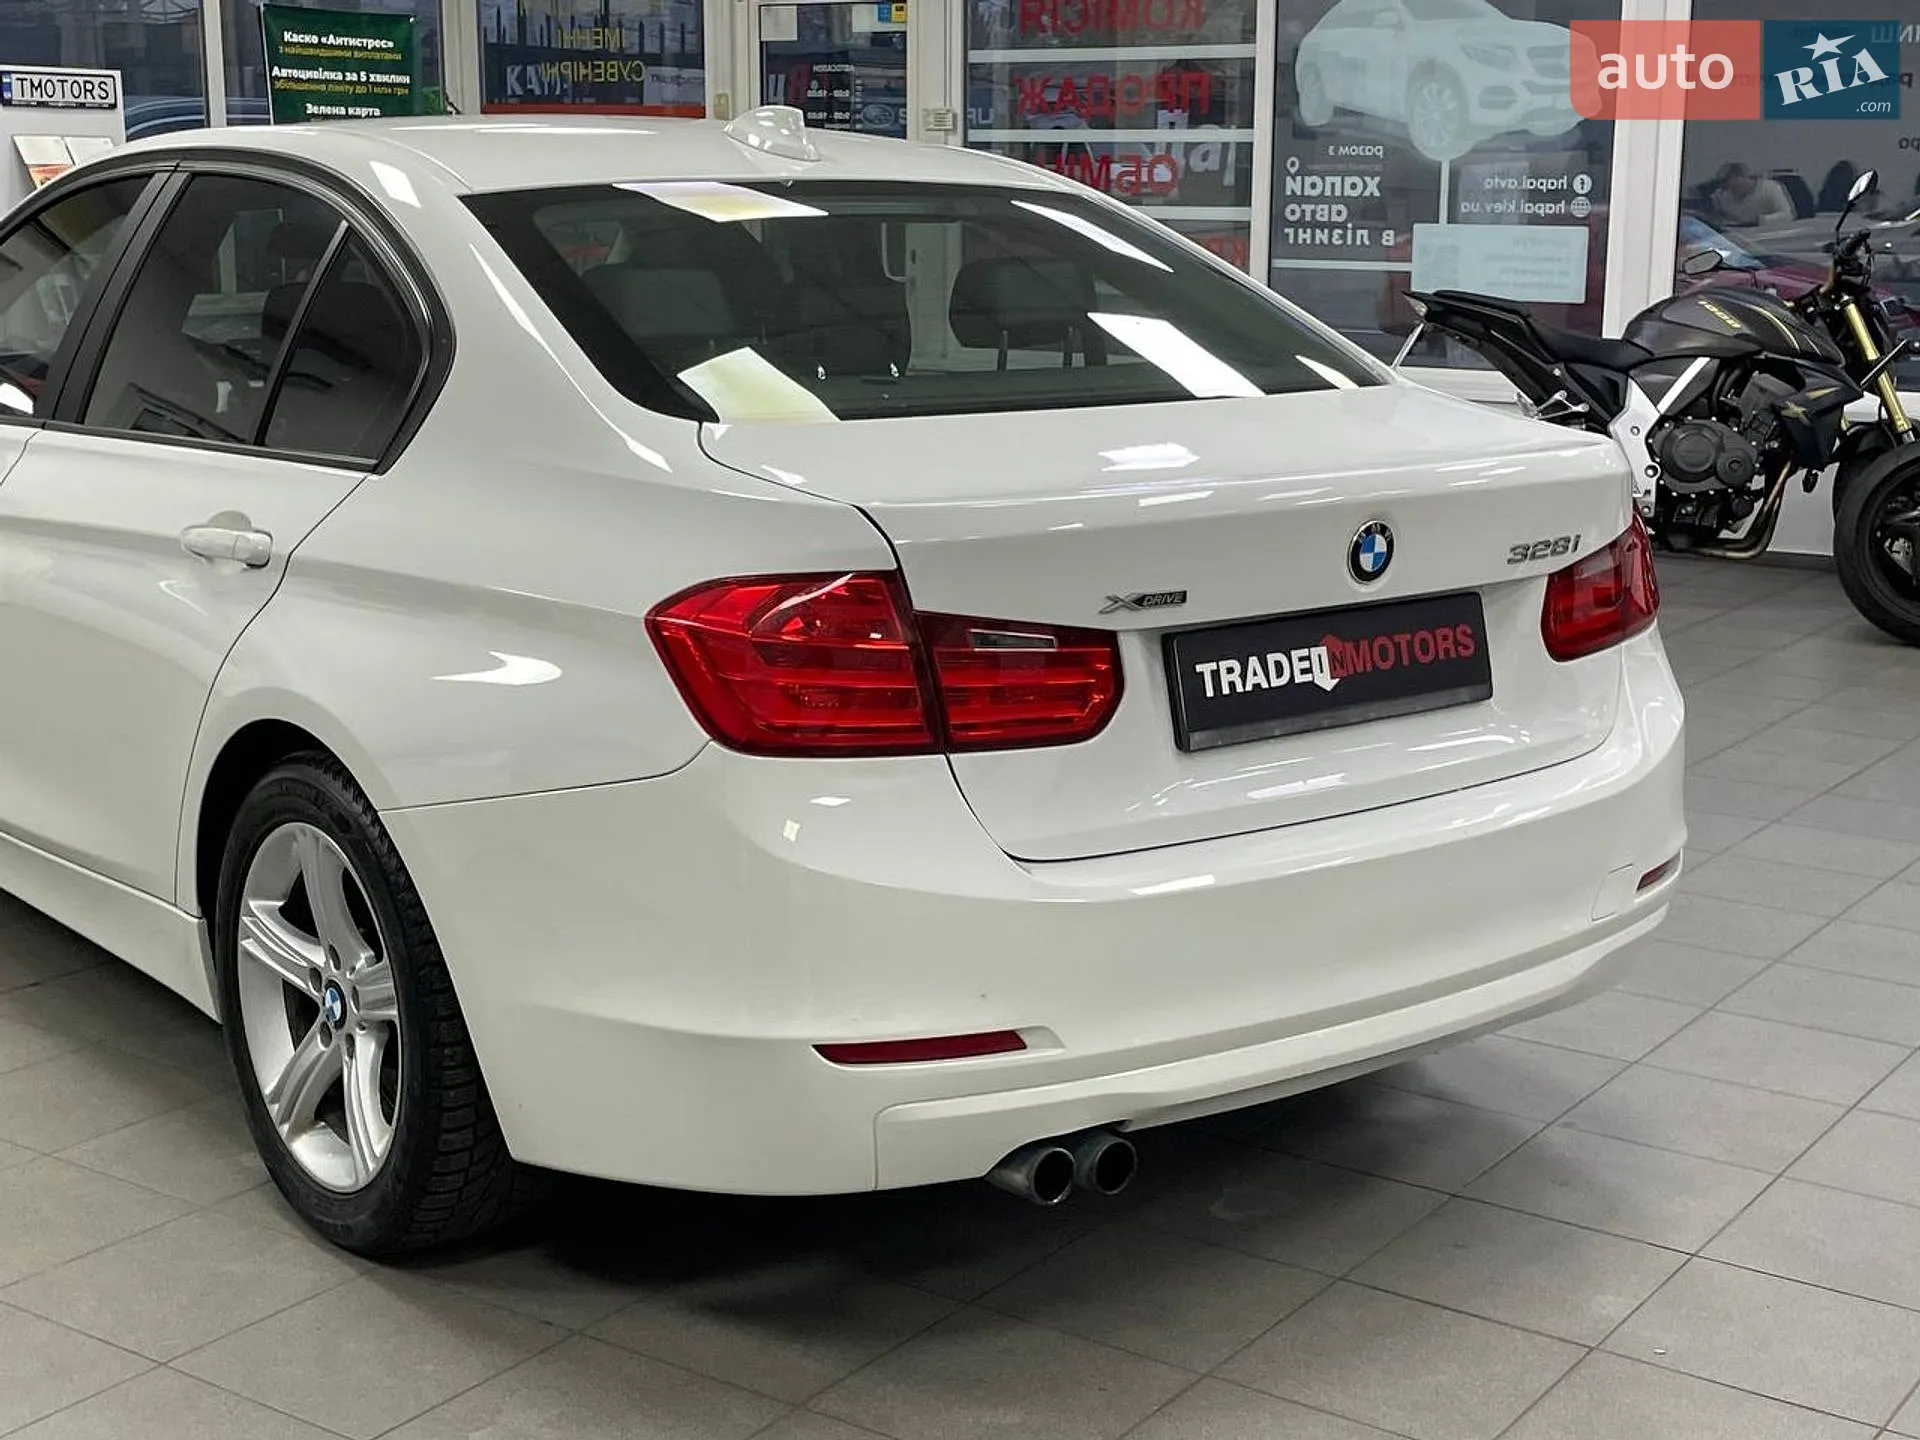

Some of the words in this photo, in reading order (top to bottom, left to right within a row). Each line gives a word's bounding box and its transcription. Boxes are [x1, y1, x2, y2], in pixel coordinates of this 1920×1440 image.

[283, 31, 319, 44] Каско
[272, 66, 343, 81] Автоцивілка
[345, 72, 358, 81] за
[360, 71, 367, 82] 5
[369, 73, 411, 84] хвилин
[15, 77, 109, 100] TMOTORS
[306, 103, 346, 115] Зелена
[348, 106, 381, 118] карта
[1506, 533, 1582, 565] 328i
[1195, 646, 1313, 698] TRADE
[1343, 623, 1476, 676] MOTORS
